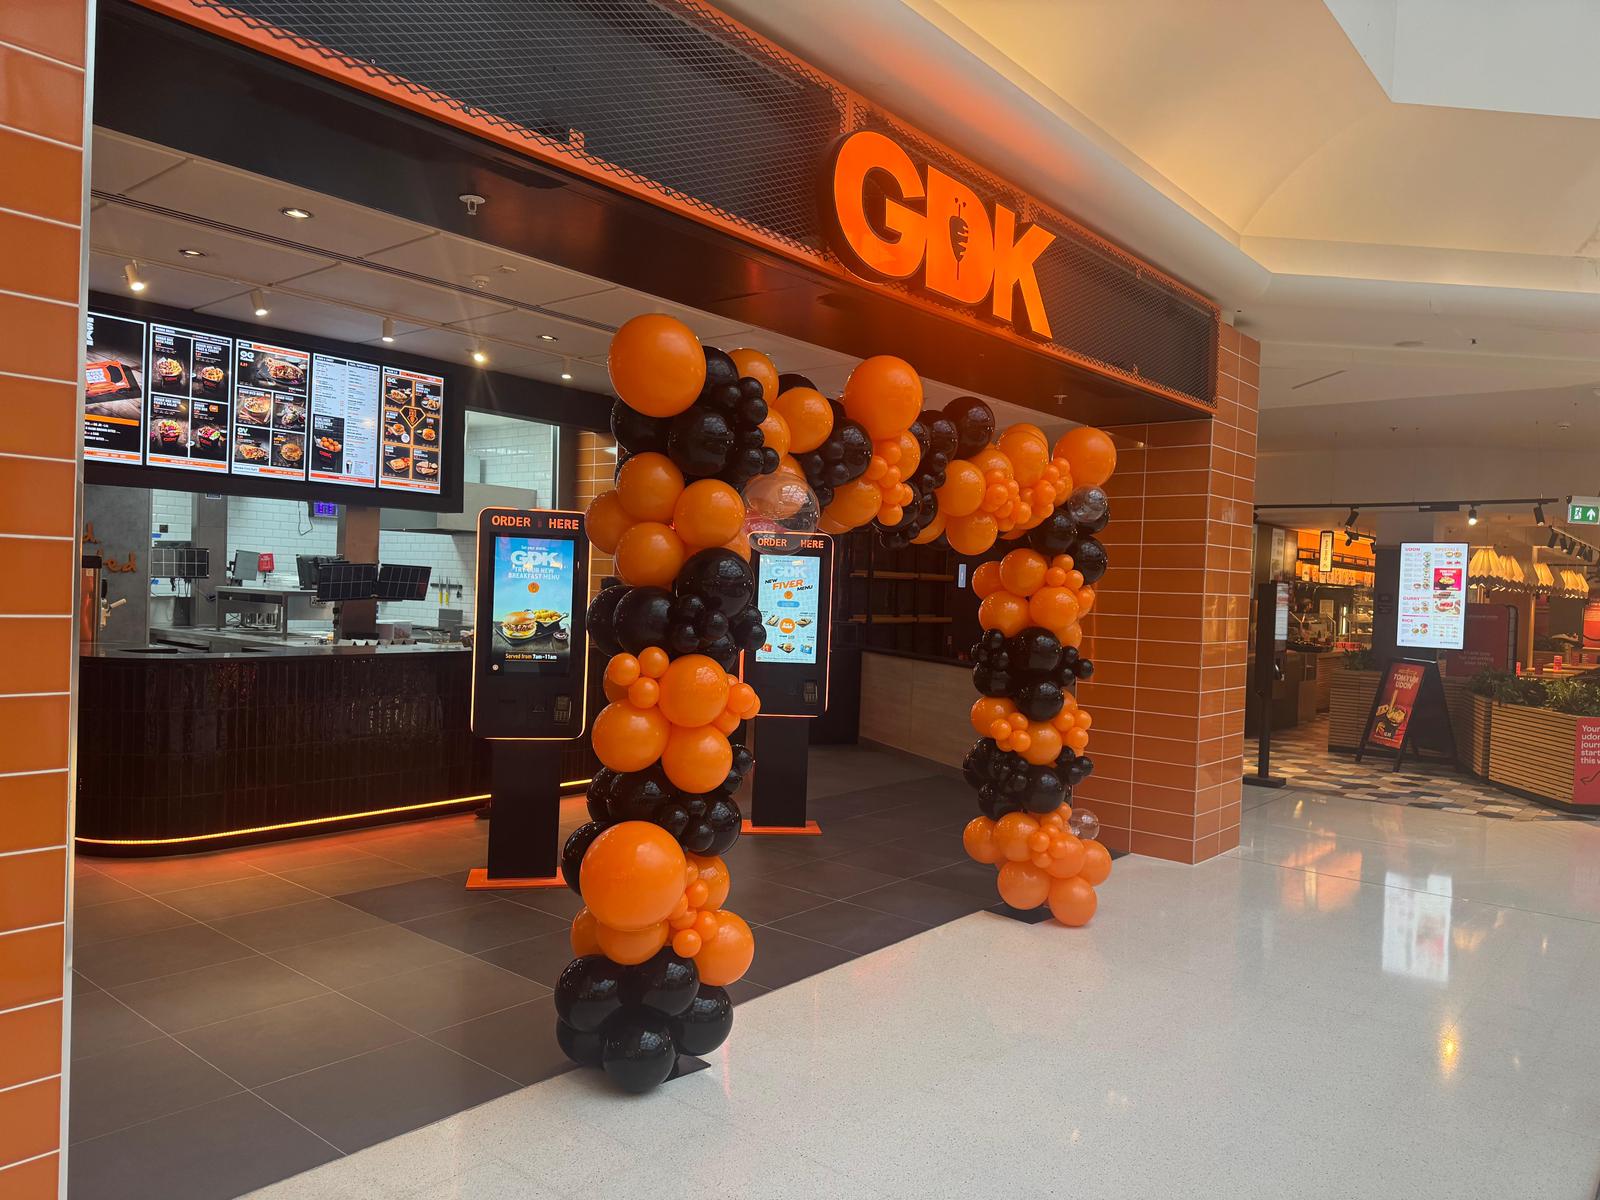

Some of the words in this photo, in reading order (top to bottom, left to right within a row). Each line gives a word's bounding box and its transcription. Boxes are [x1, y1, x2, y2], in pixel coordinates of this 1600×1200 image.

[834, 131, 1056, 339] GDK
[491, 515, 531, 527] ORDER
[548, 518, 579, 530] HERE
[757, 538, 788, 547] ORDER
[800, 539, 825, 549] HERE
[510, 550, 559, 566] GDK
[508, 572, 542, 580] BREAKFAST
[771, 565, 807, 579] GDK
[772, 579, 804, 591] FIVER
[1581, 757, 1596, 765] this
